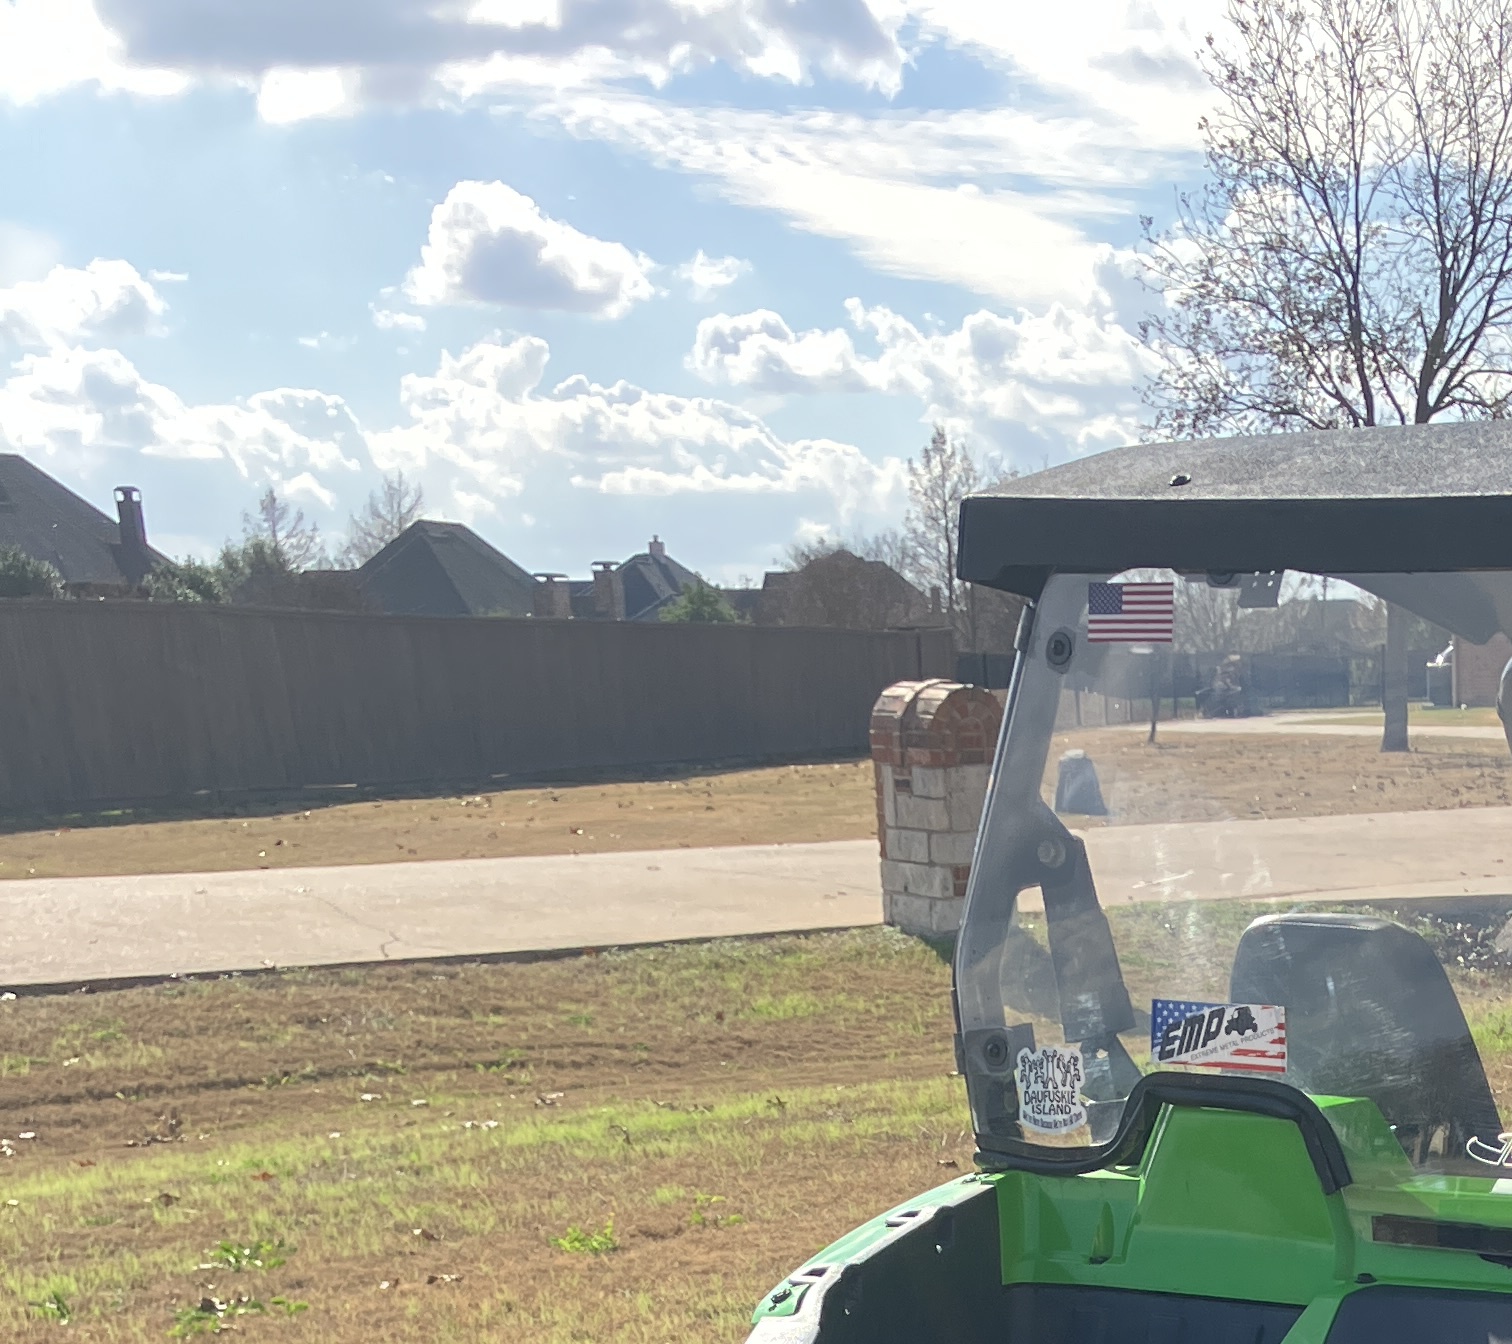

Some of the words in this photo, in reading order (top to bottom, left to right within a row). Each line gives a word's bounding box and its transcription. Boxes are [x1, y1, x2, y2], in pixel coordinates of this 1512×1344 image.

[1158, 1007, 1226, 1062] EMP
[1190, 1046, 1218, 1061] EXTREME
[1220, 1040, 1239, 1051] METAL
[1241, 1027, 1275, 1044] PRODUCTS
[1023, 1090, 1077, 1106] DAUFUSKIE
[1031, 1103, 1072, 1115] ISLAND
